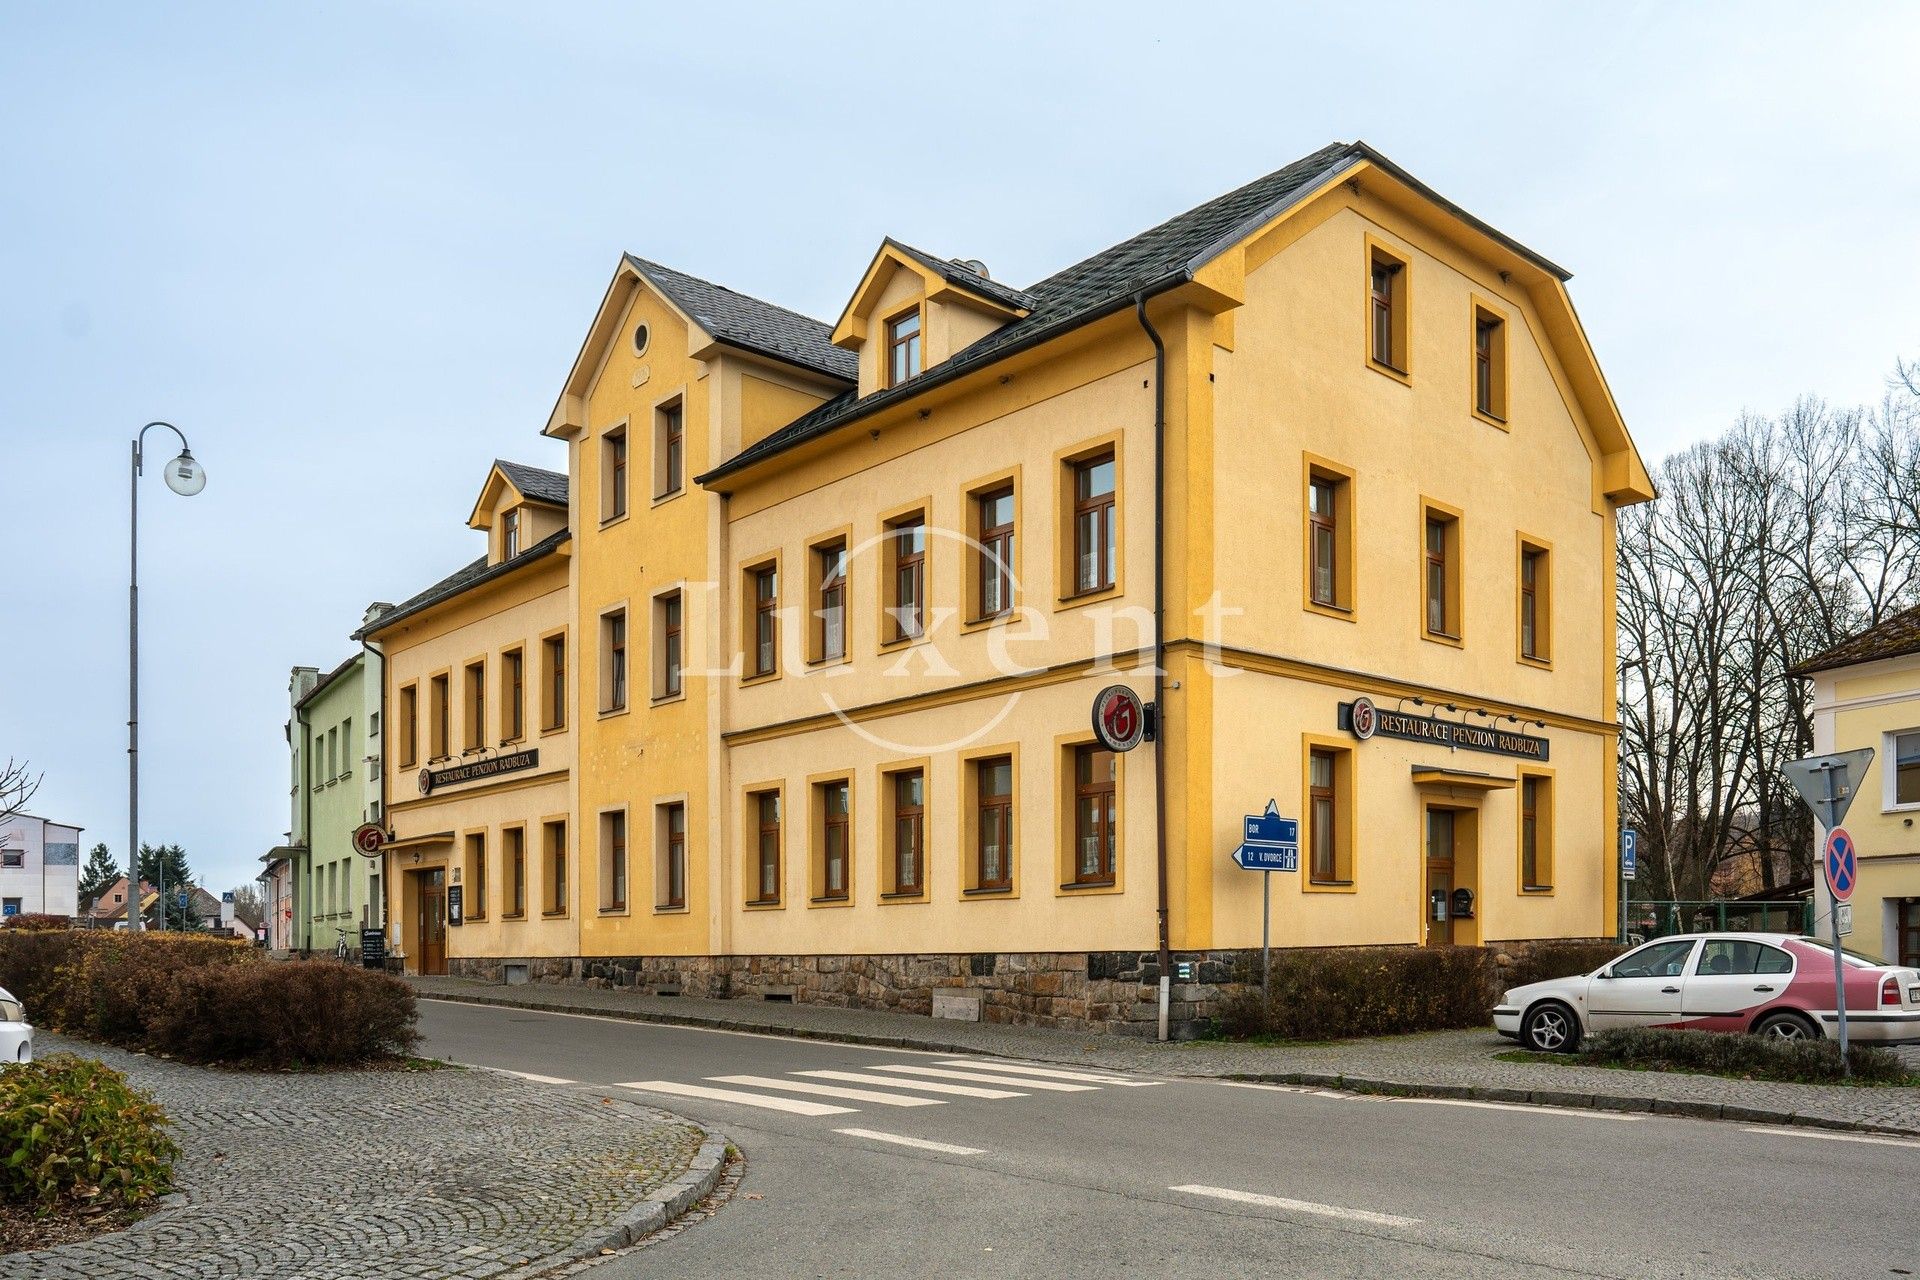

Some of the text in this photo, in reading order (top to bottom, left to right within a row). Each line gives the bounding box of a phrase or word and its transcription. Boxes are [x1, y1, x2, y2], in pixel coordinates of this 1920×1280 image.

[1380, 714, 1541, 756] RESTAURACE PENZION RADBUZA
[435, 753, 531, 784] RESTAURACE PENZION RADBUZA
[1248, 823, 1259, 834] BOR
[1247, 851, 1254, 862] 12
[1625, 834, 1633, 858] P
